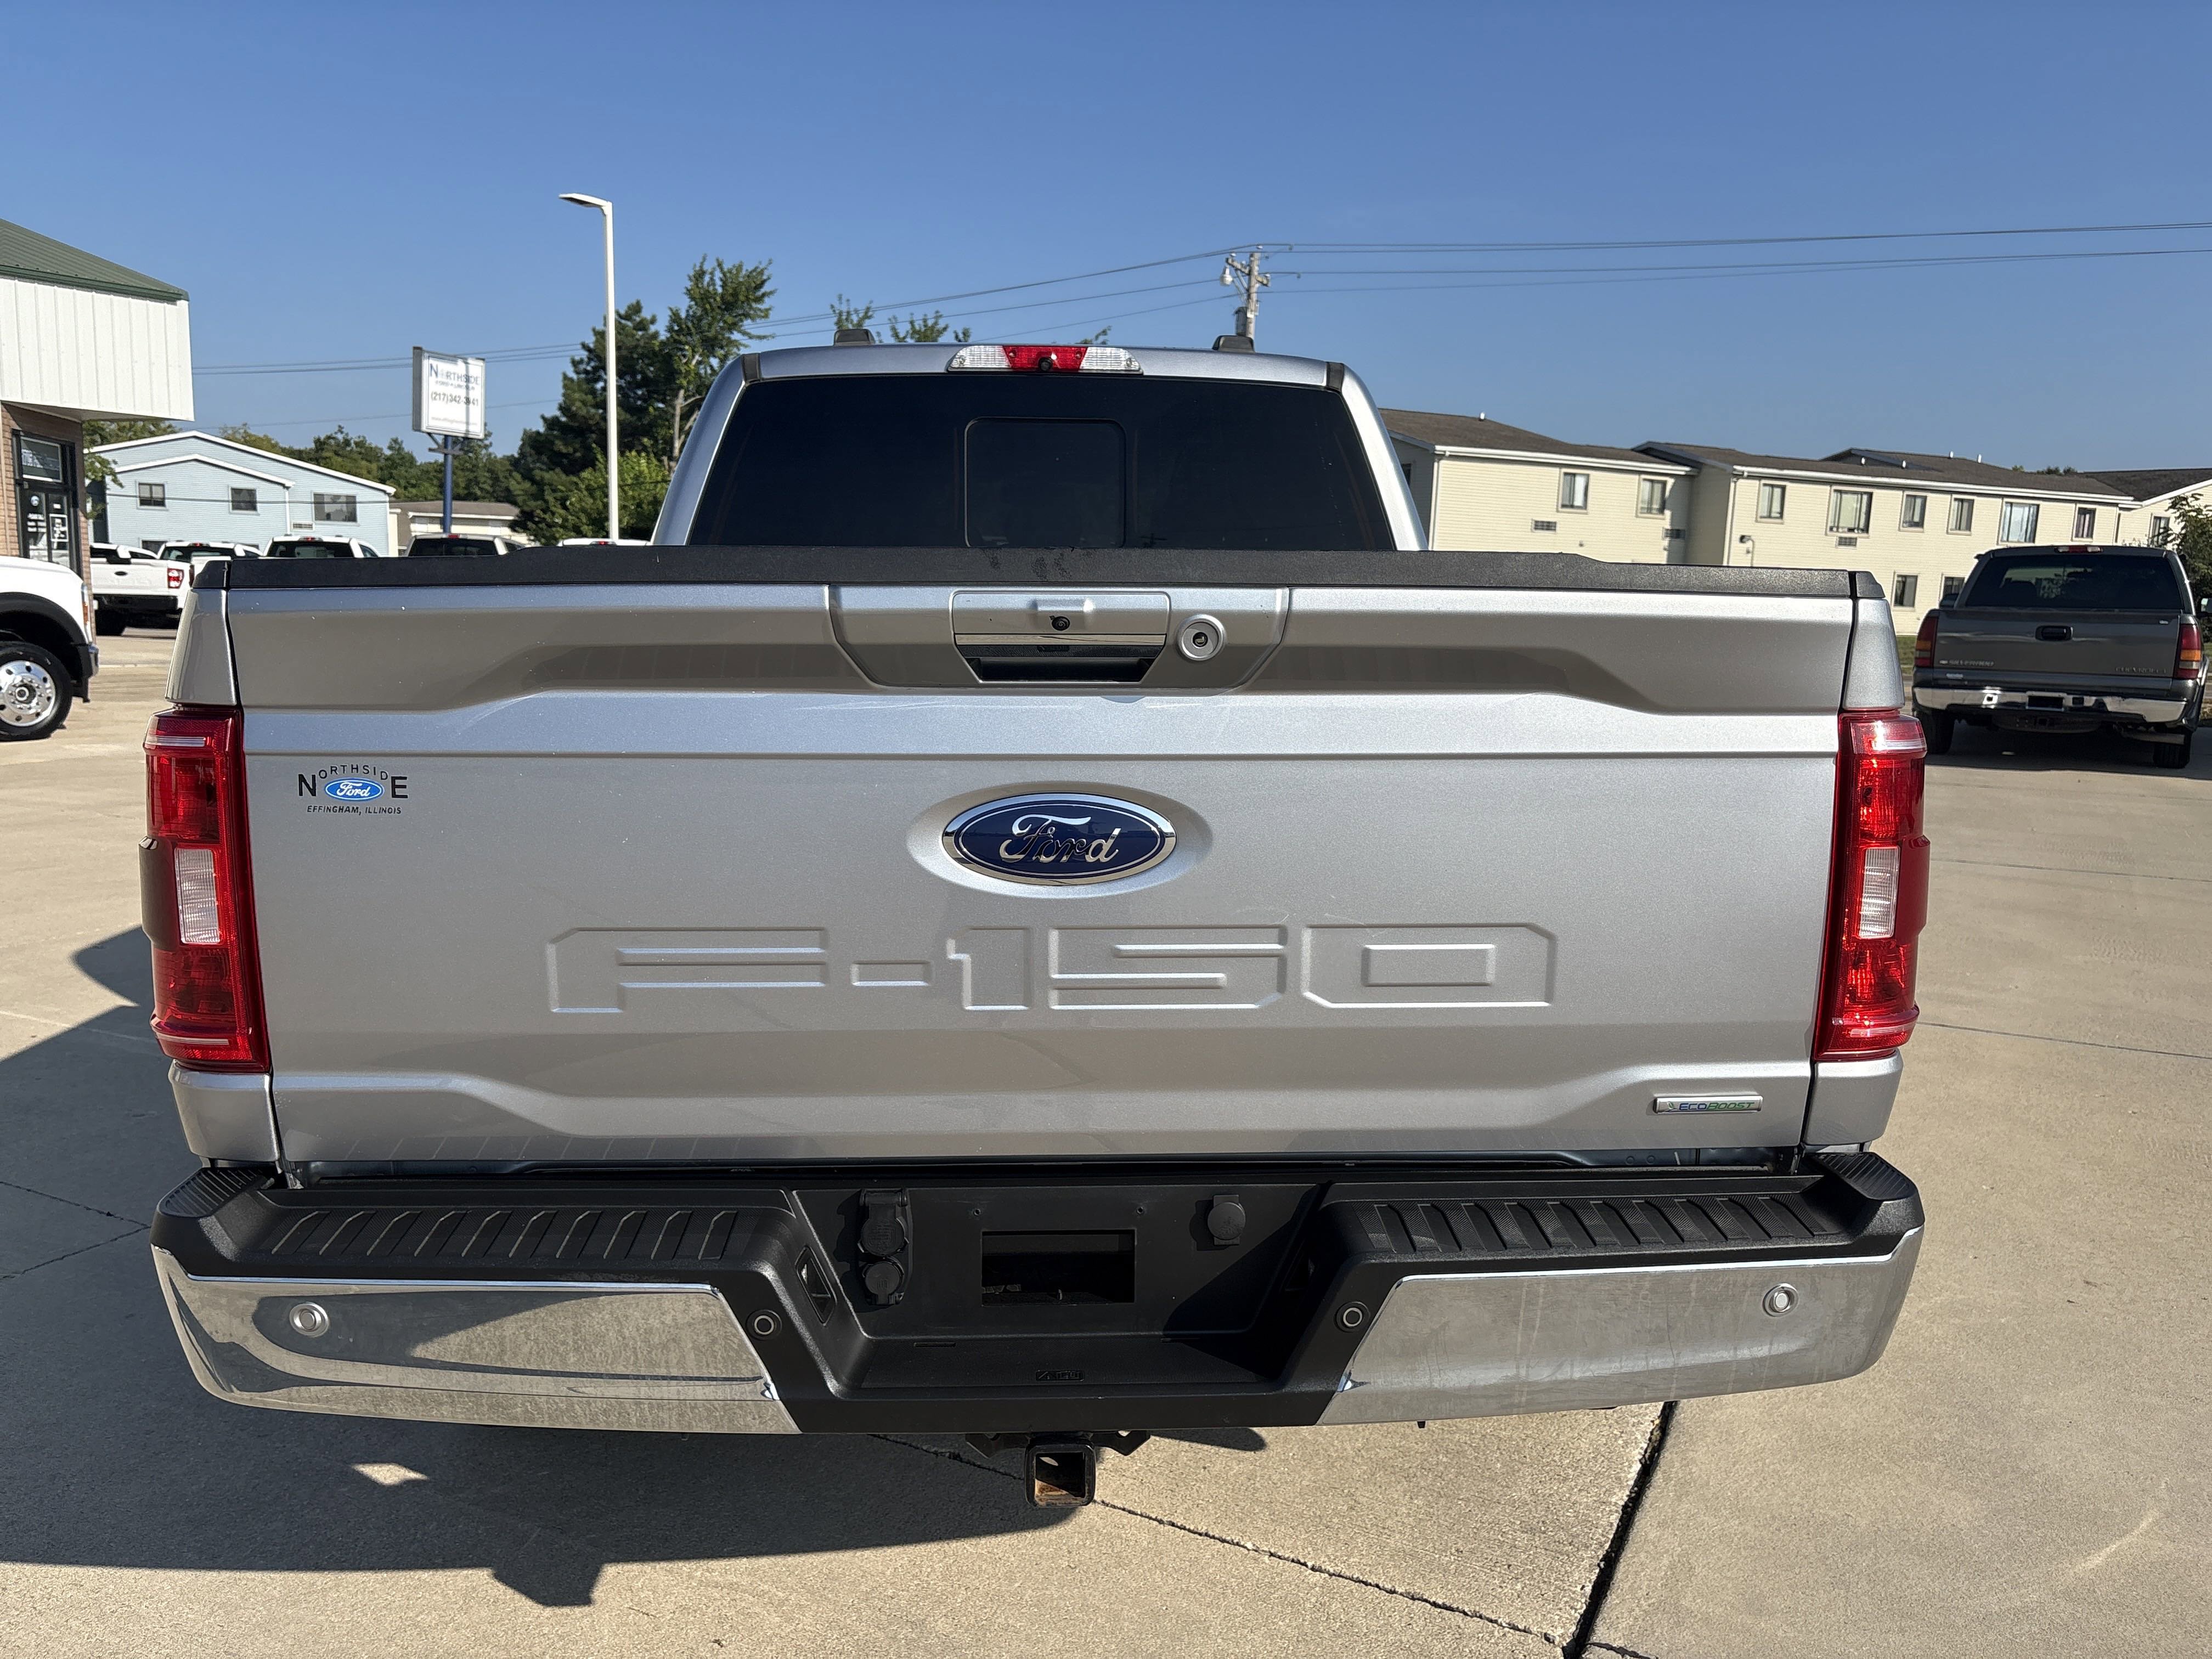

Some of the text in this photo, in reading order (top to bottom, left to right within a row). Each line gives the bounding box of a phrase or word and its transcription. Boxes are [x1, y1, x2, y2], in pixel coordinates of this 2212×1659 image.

[298, 764, 408, 799] NORTHSIDE
[336, 782, 371, 797] Ford
[307, 805, 361, 815] EFFINGHAM,
[998, 814, 1122, 863] Ford
[548, 923, 1558, 1013] F-150
[1679, 1102, 1755, 1111] ECOBOOST
